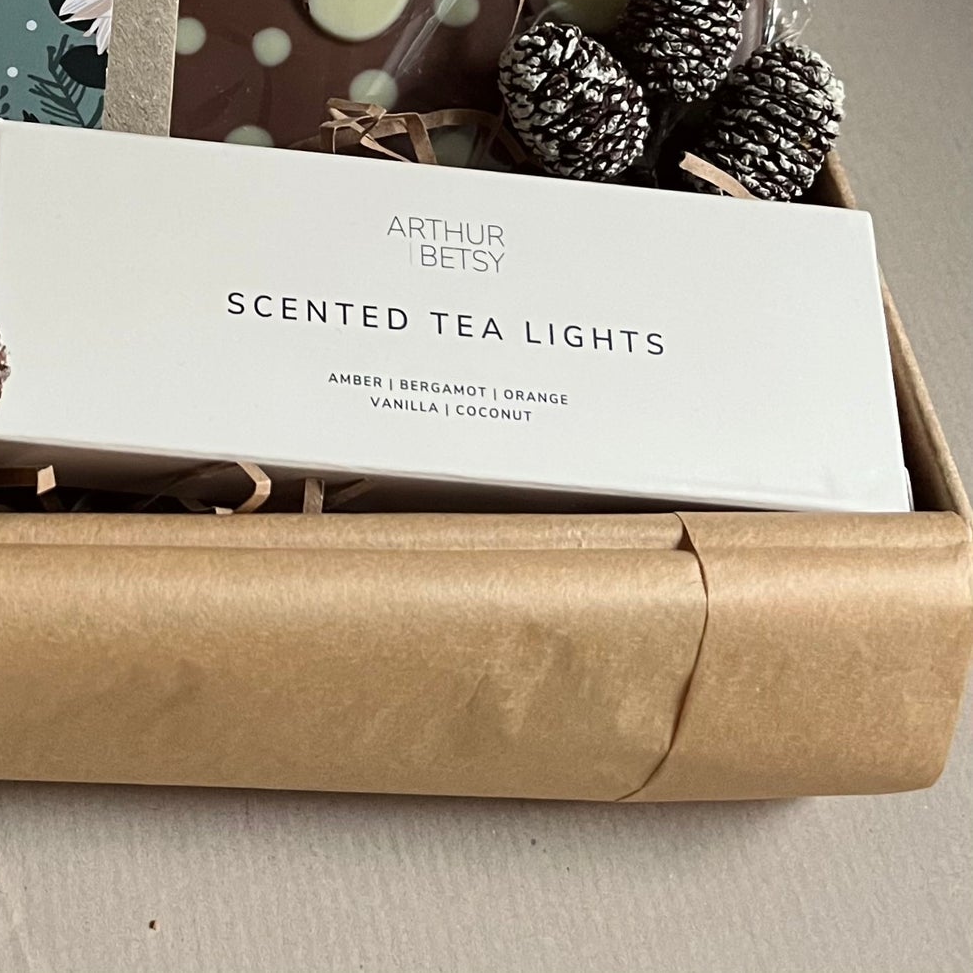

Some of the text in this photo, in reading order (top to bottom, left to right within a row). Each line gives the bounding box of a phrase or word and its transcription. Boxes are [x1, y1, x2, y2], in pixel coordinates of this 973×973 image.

[386, 215, 505, 248] ARTHUR
[420, 244, 505, 274] BETSY
[227, 292, 664, 356] SCENTED TEA LIGHTS
[328, 372, 382, 388] AMBER
[400, 379, 487, 398] BERGAMOT
[503, 389, 568, 405] ORANGE
[370, 396, 439, 413] VANILLA
[455, 404, 532, 421] COCONUT
